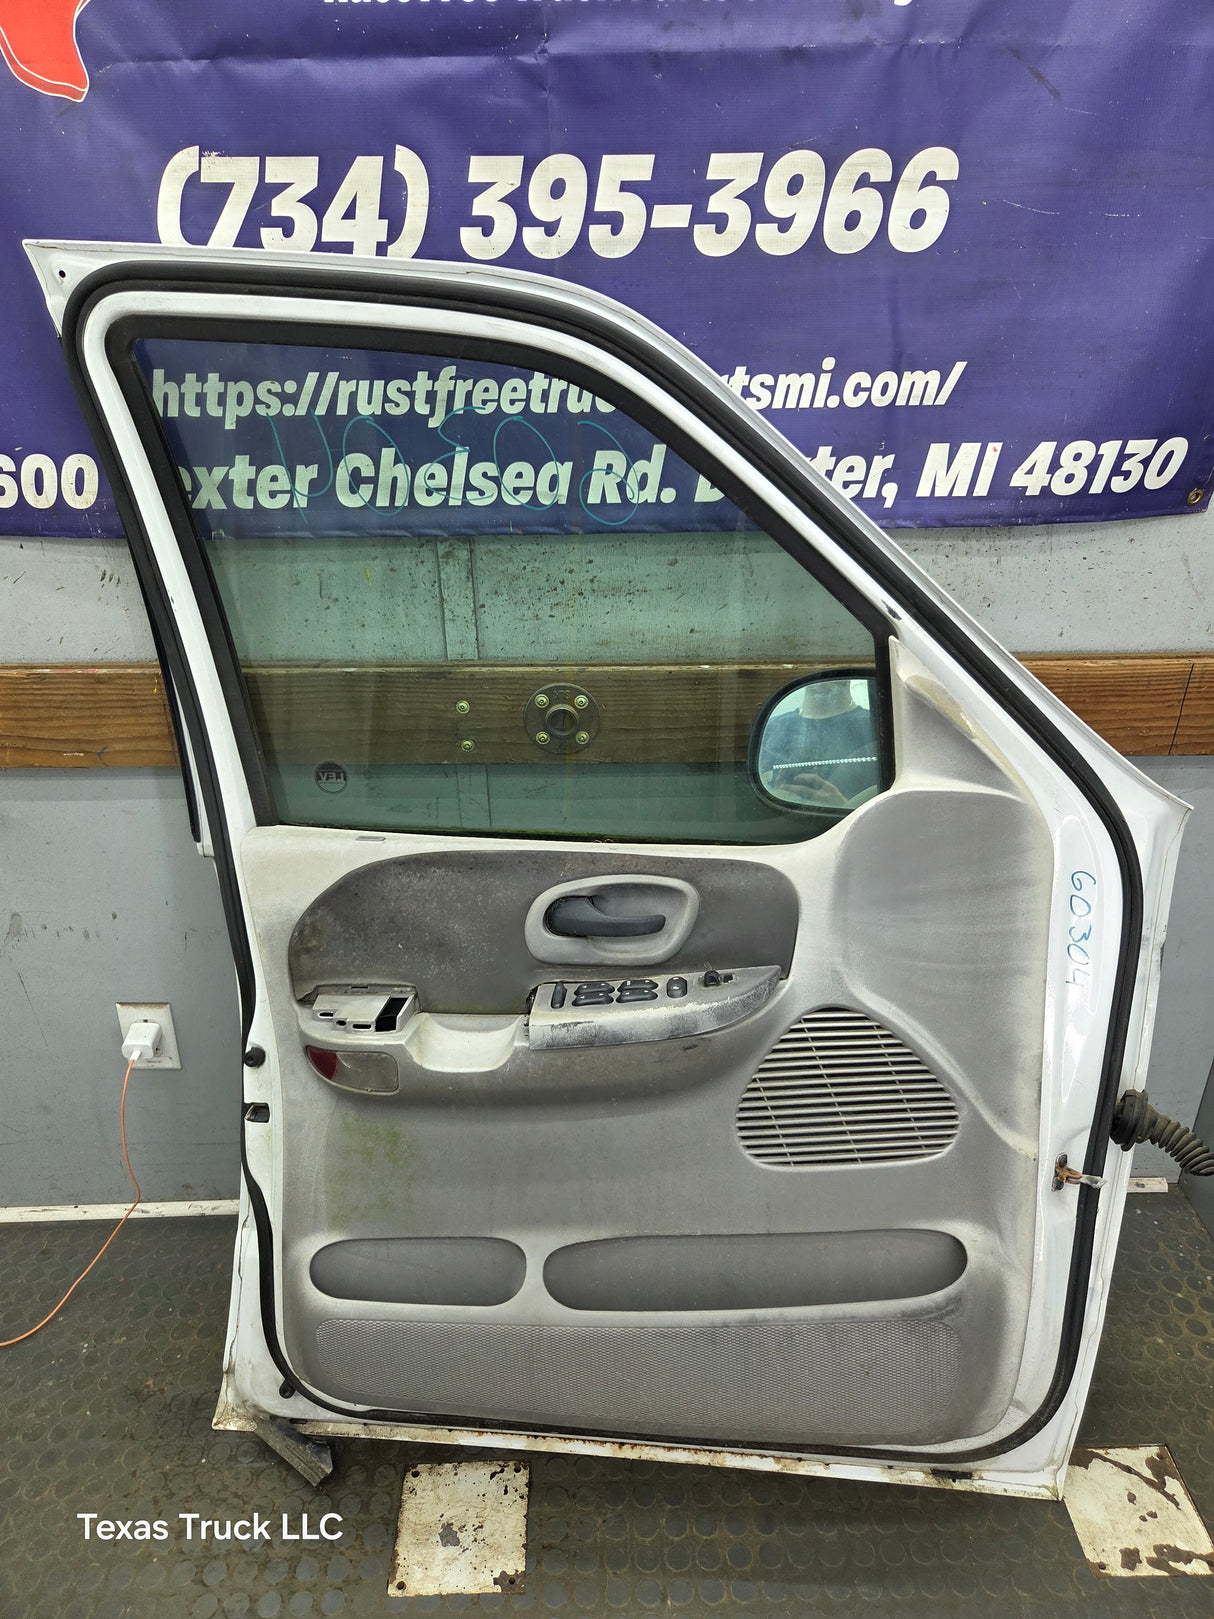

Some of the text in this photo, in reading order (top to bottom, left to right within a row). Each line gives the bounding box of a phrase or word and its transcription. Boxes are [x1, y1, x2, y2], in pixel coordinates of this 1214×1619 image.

[157, 144, 960, 260] (734) 395-3966
[335, 447, 573, 507] Chelsea
[587, 444, 677, 504] Rd.
[915, 442, 1003, 497] MI
[1009, 437, 1189, 496] 48130
